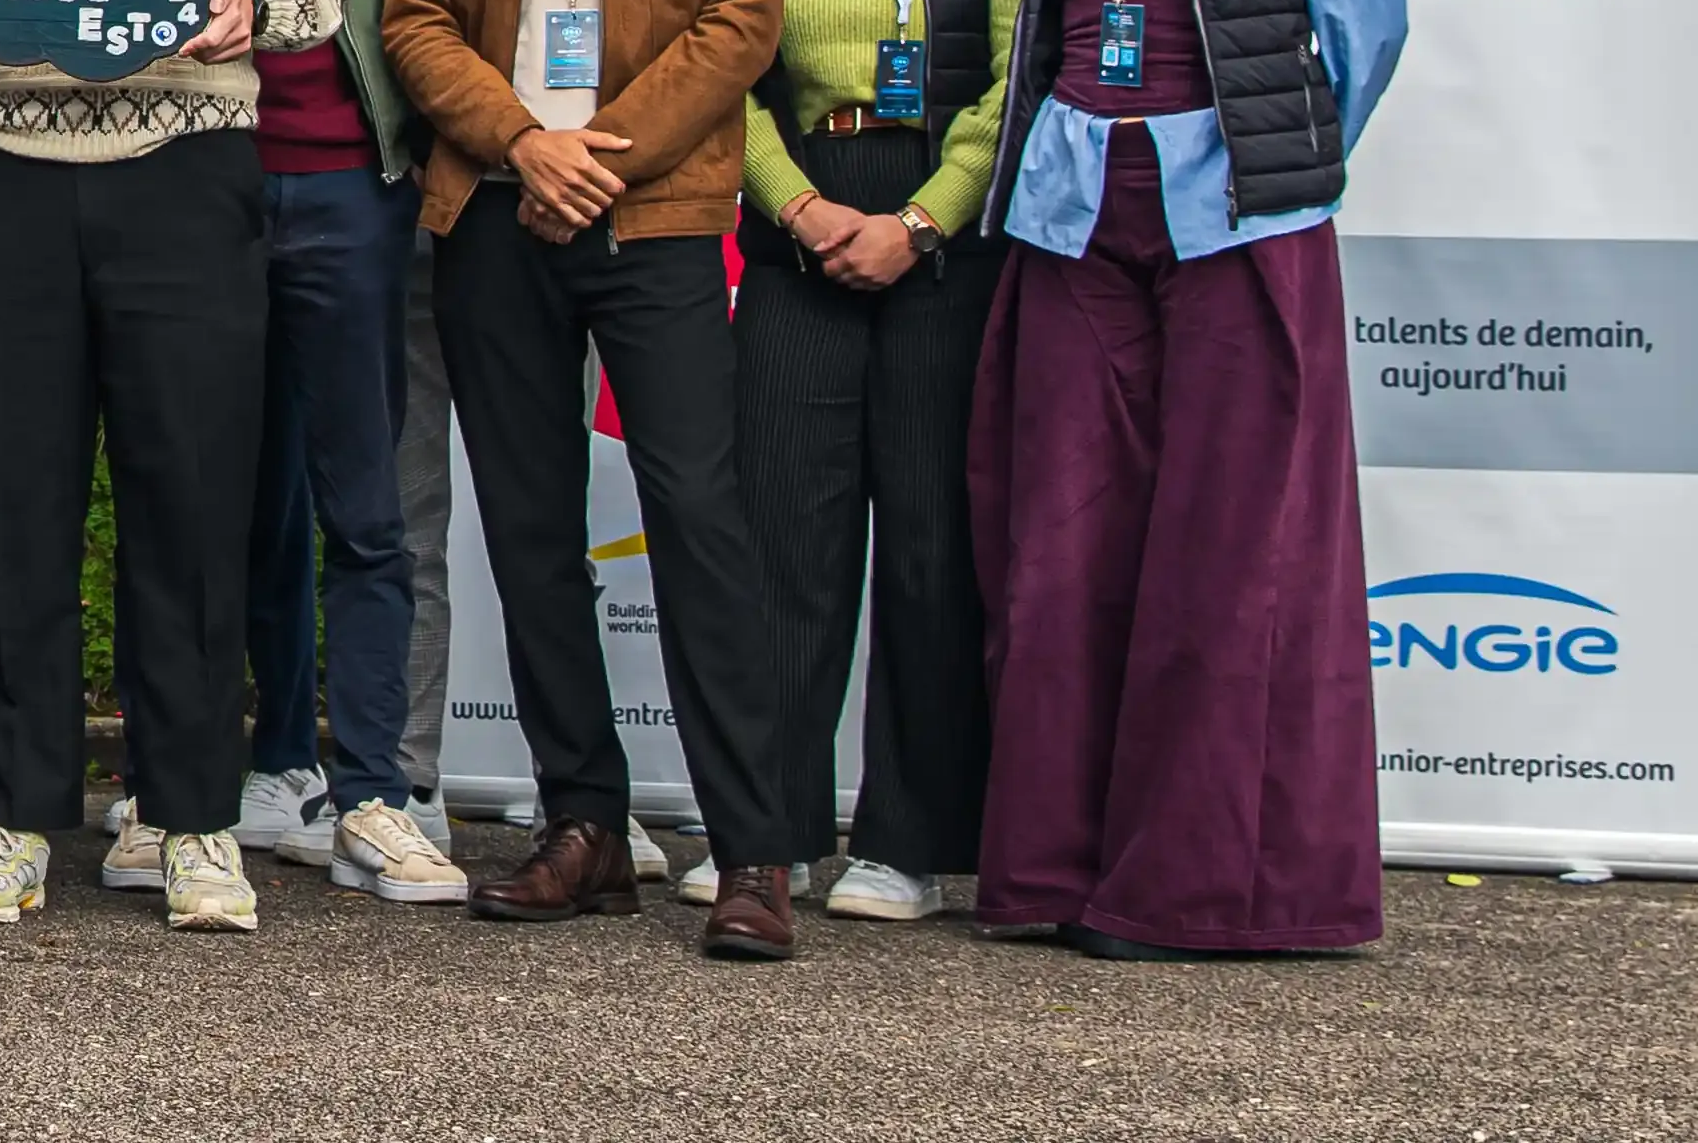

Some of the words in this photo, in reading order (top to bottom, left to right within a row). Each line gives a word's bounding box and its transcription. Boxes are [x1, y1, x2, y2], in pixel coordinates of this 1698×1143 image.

[1354, 316, 1468, 346] talents
[1476, 319, 1516, 346] de
[1524, 320, 1653, 354] demain,
